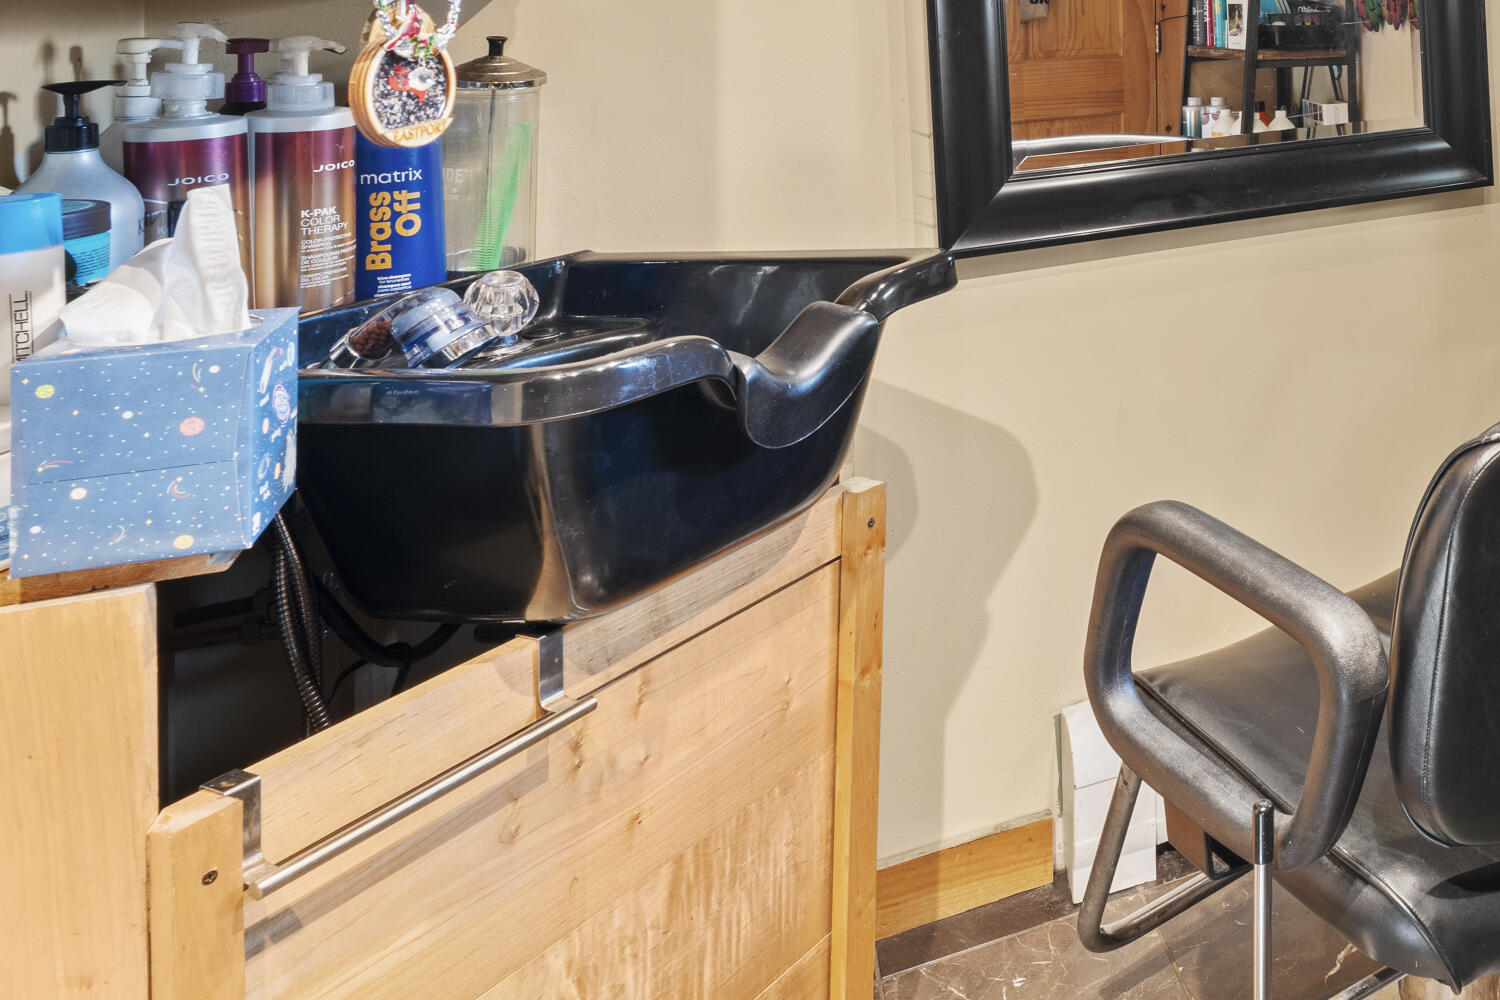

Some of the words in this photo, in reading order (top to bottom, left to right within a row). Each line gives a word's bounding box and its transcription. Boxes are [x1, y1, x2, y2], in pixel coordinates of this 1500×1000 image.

[313, 159, 355, 173] JOICO
[168, 172, 229, 186] JOICO
[360, 167, 422, 185] matrix
[301, 206, 336, 218] K-PAK
[393, 190, 422, 237] Off
[301, 214, 340, 227] COLOR
[300, 221, 348, 236] THERAPY
[365, 191, 392, 270] Brass
[301, 241, 332, 250] SHAMPOO
